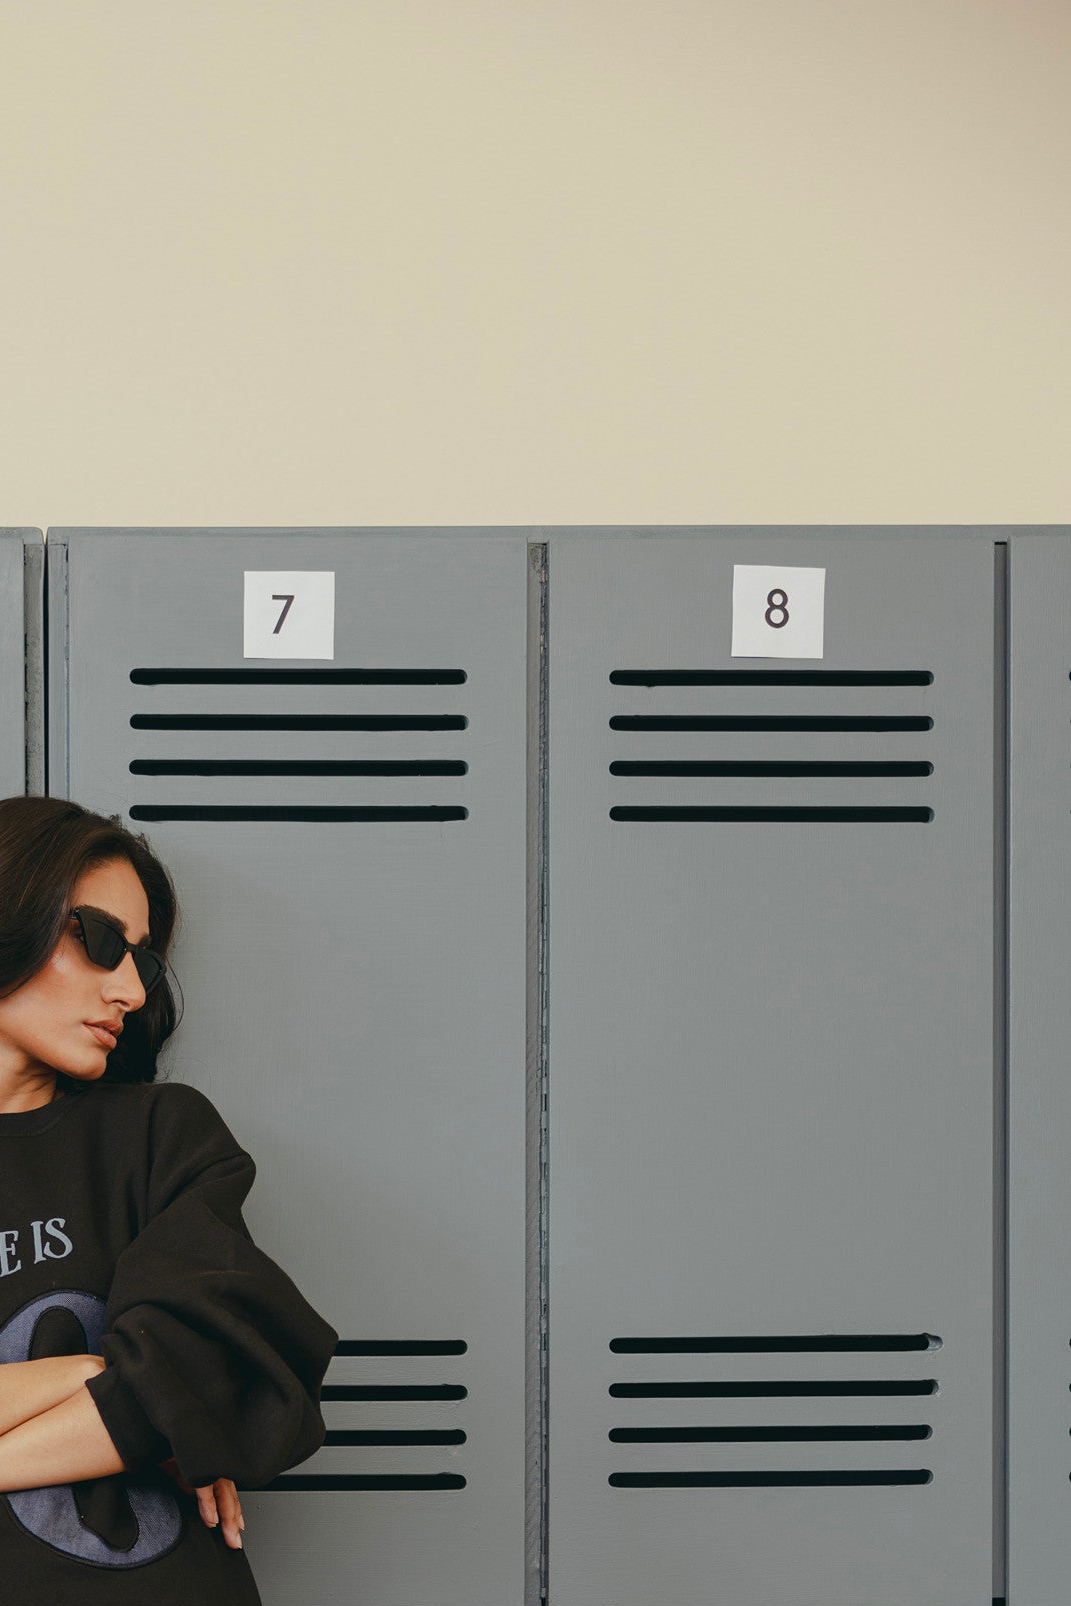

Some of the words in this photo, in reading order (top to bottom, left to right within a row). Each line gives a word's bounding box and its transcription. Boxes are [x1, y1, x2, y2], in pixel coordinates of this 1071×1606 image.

[271, 594, 295, 635] 7
[764, 588, 790, 629] 8
[30, 1217, 73, 1265] IS
